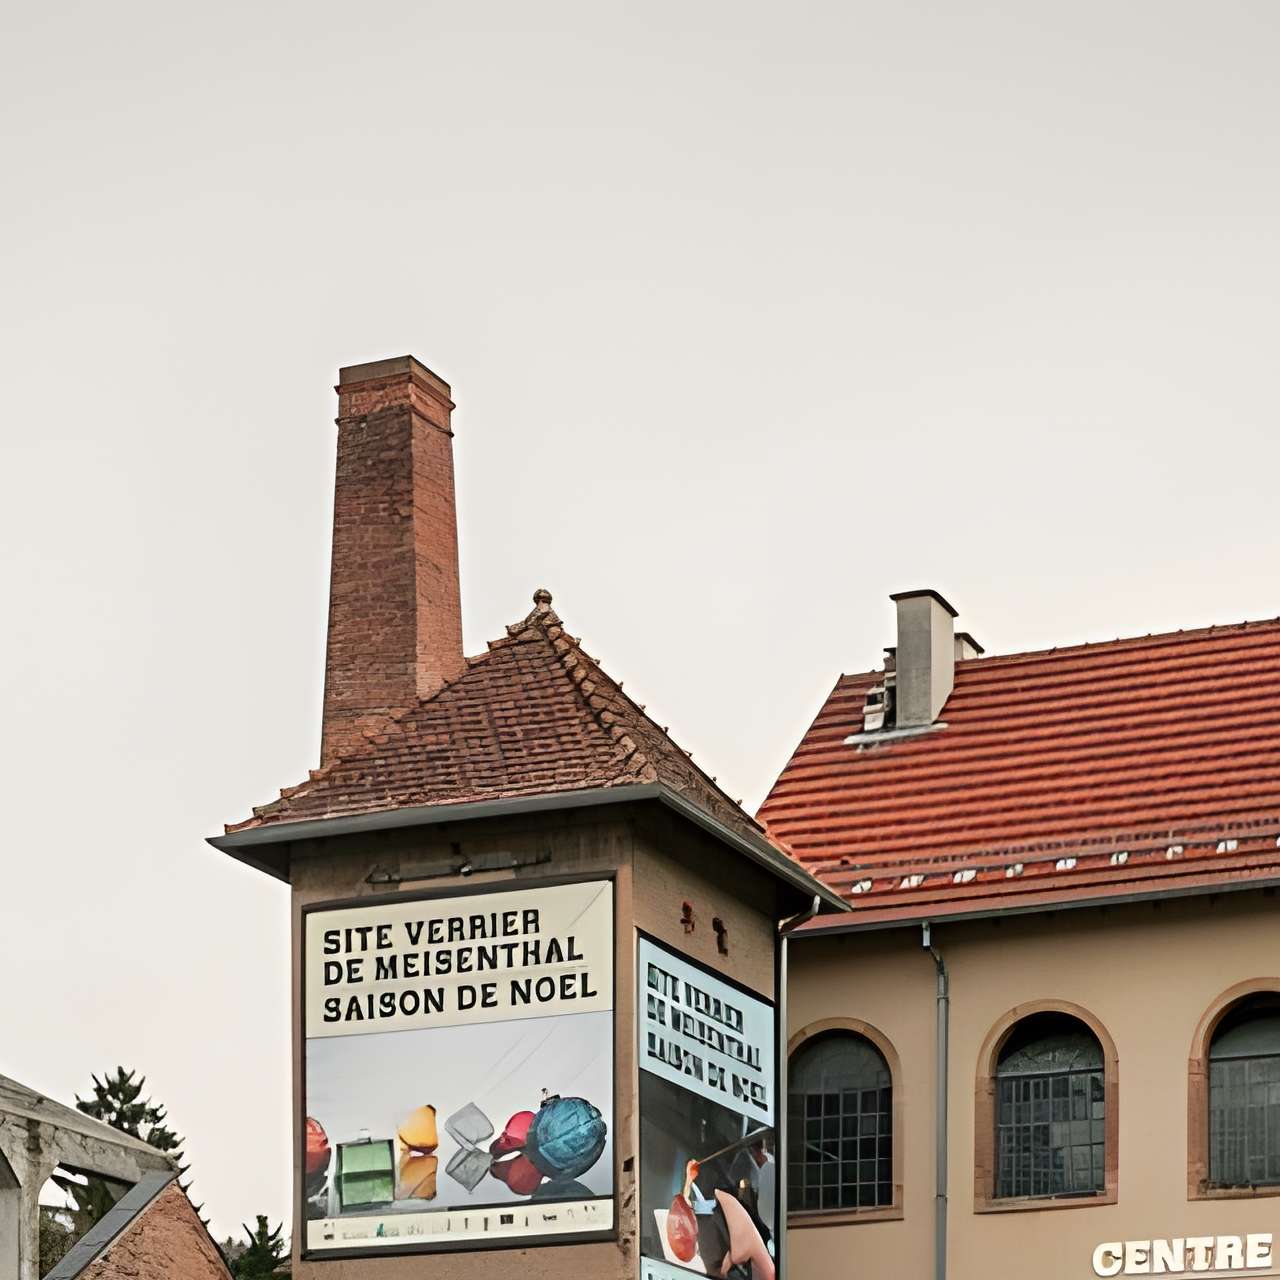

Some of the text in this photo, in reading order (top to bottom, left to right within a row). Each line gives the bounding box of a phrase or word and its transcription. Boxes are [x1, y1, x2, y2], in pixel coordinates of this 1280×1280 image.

[323, 909, 540, 954] SITE VERRIER
[324, 936, 584, 985] DE MEISENTHAL
[323, 987, 444, 1022] SAISON
[457, 983, 498, 1010] DE
[1092, 1233, 1273, 1277] CENTRE
